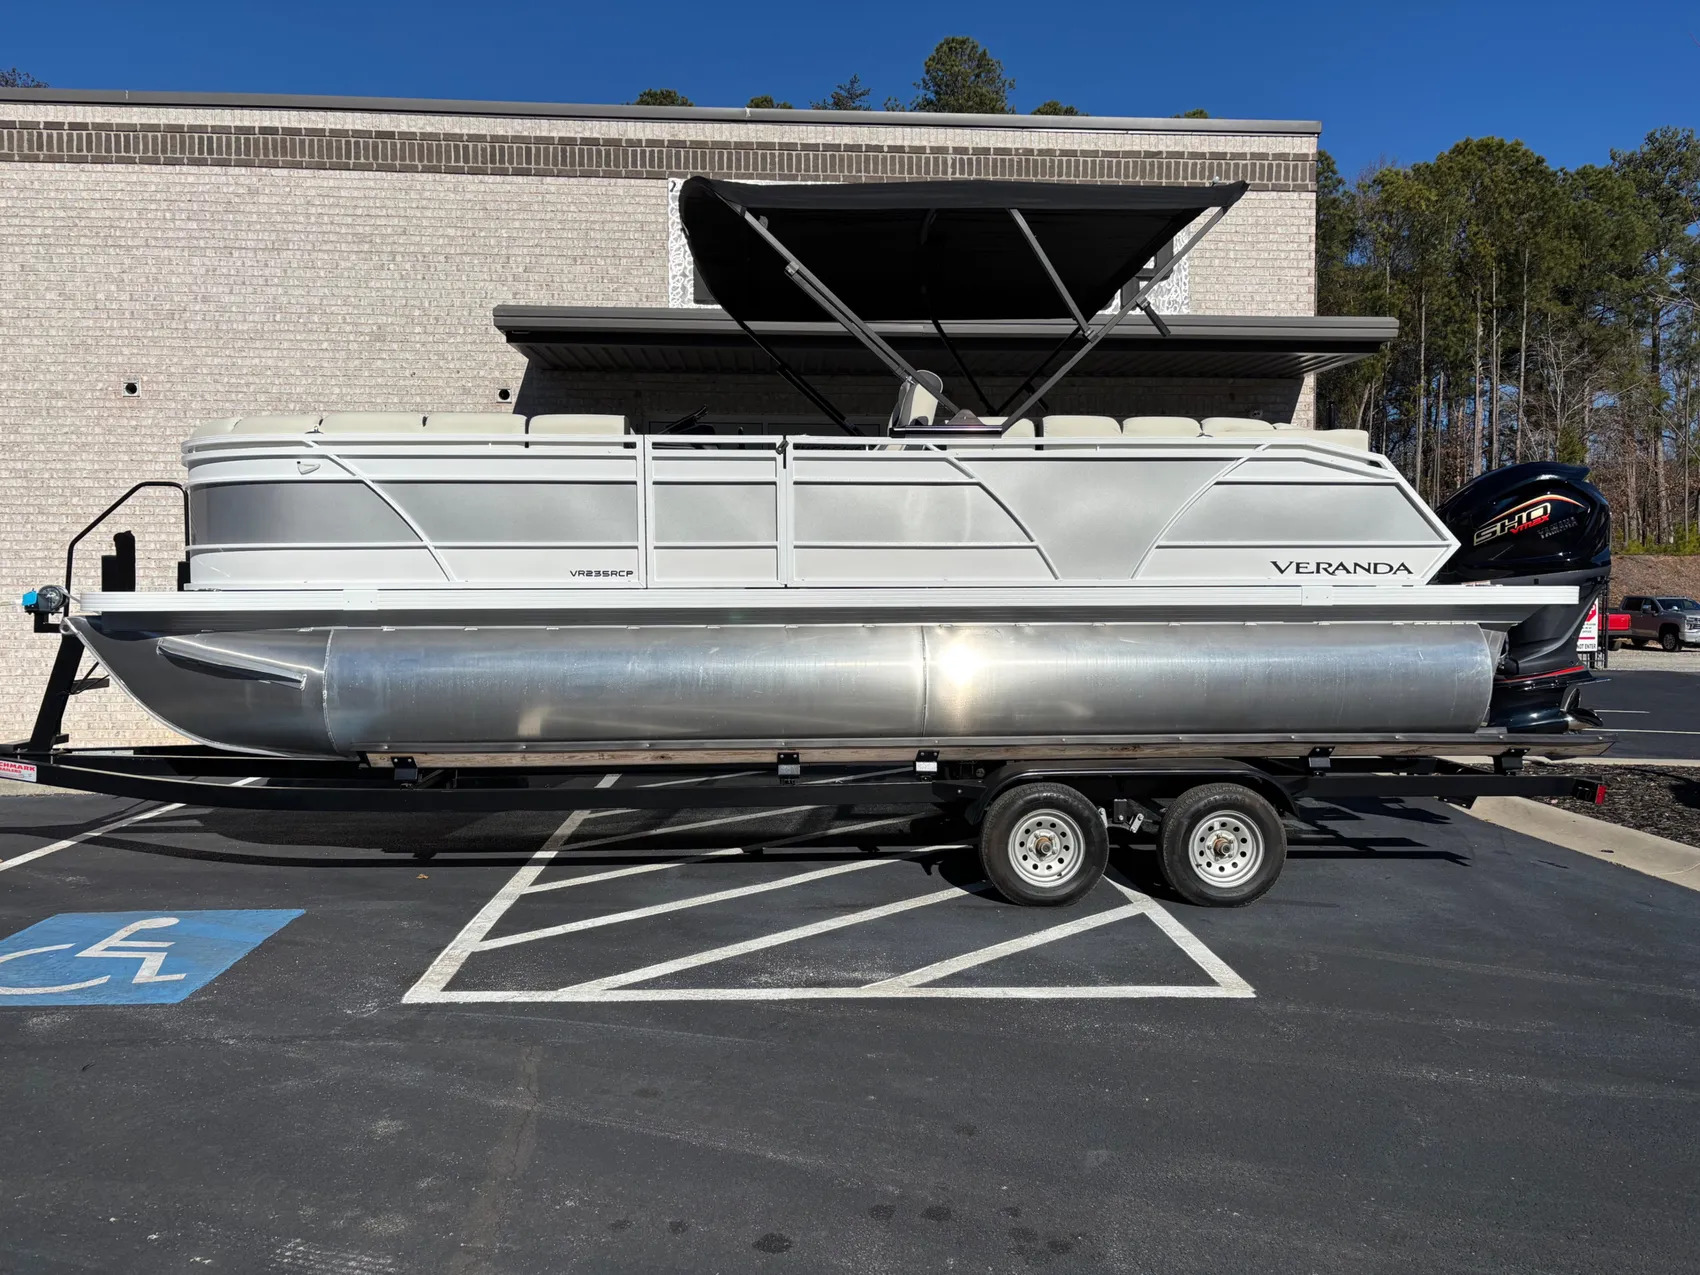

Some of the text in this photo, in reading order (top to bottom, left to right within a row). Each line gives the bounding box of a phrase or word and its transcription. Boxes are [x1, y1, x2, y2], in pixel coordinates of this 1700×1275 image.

[1473, 502, 1551, 546] SHO
[1537, 516, 1578, 539] YAMAHA
[1270, 561, 1414, 576] VERANDA
